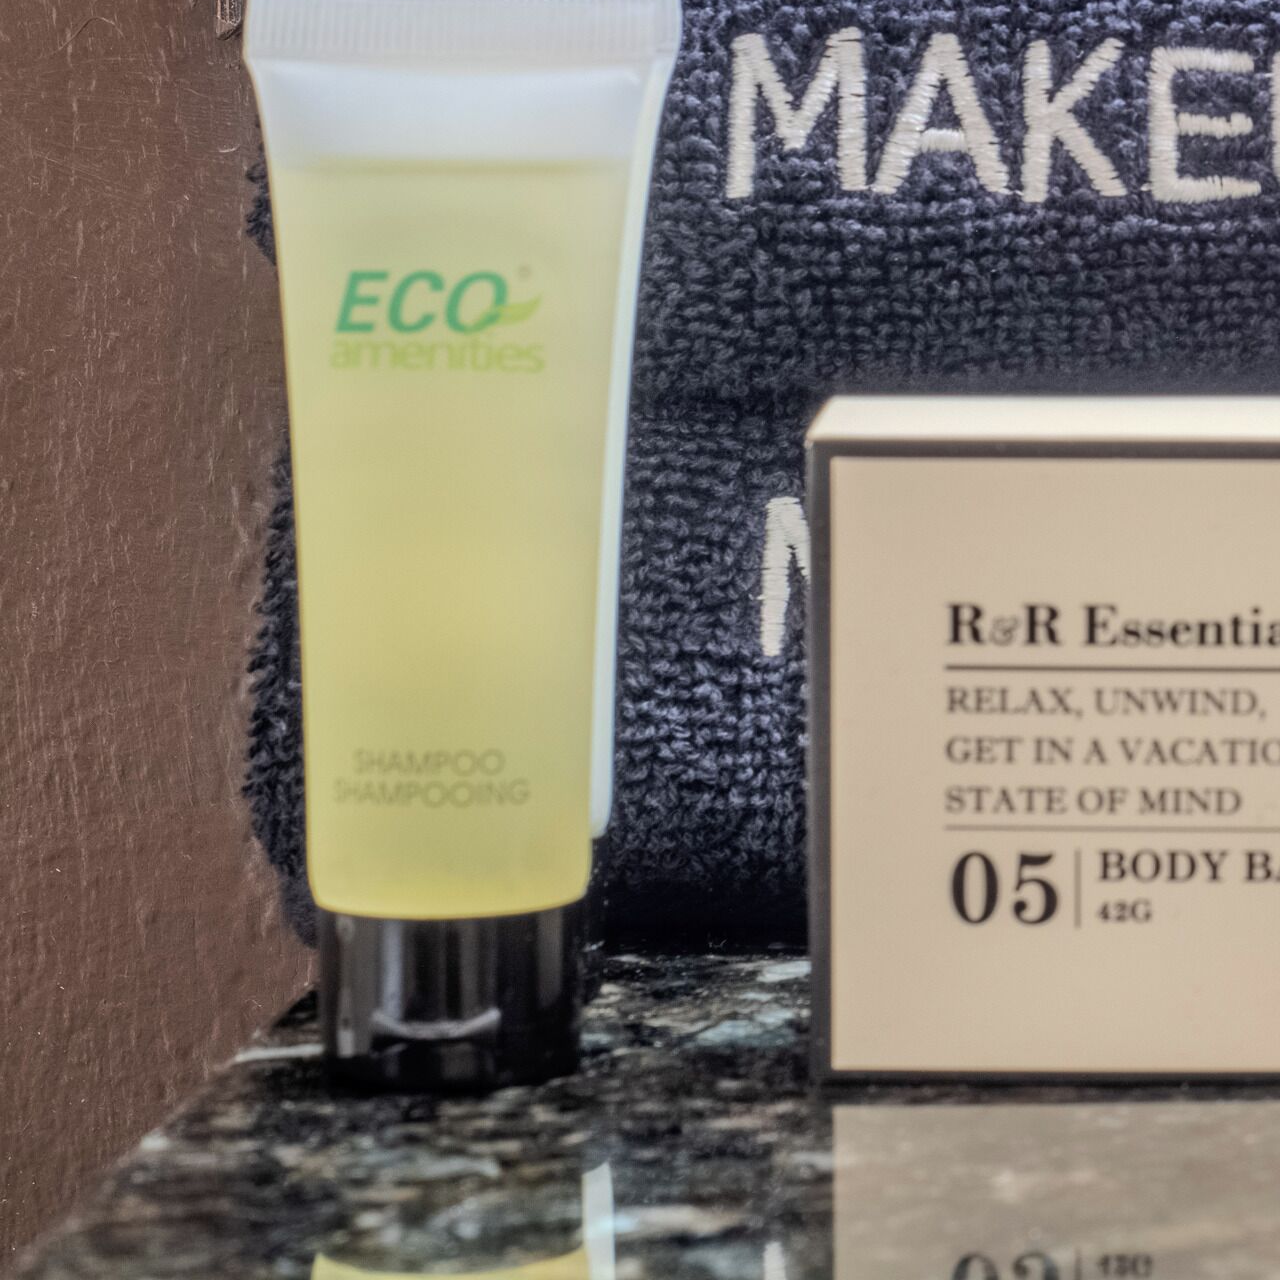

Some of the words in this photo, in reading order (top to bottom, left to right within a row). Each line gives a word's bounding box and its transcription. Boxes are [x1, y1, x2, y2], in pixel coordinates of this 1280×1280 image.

[335, 269, 509, 335] ECO
[329, 336, 546, 373] amenities
[945, 686, 1084, 719] RELAX,
[1094, 687, 1267, 720] UNWIND,
[353, 748, 506, 777] SHAMPOO
[945, 736, 1022, 765] GET
[1032, 738, 1073, 765] IN
[1083, 738, 1108, 766] A
[944, 786, 1067, 815] STATE
[1076, 787, 1128, 815] OF
[1138, 788, 1243, 816] MIND
[950, 850, 1060, 925] 05
[1098, 848, 1228, 884] BODY
[1096, 898, 1153, 923] 42G
